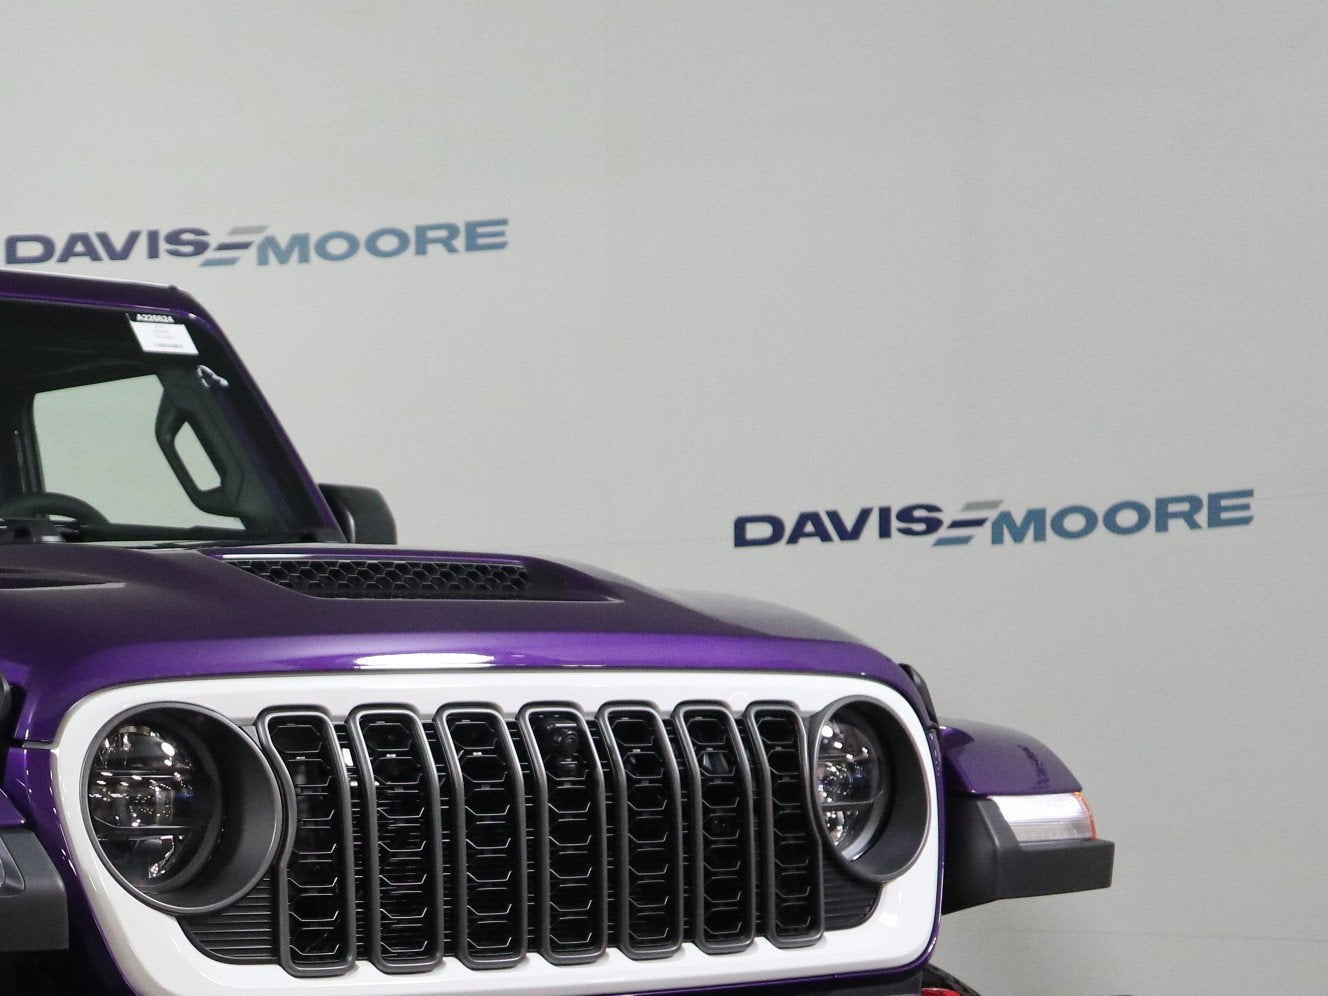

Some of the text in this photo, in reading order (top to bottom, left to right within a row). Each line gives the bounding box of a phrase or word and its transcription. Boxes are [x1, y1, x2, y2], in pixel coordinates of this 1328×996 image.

[5, 218, 510, 267] DAVIS MOORE
[733, 489, 1255, 549] DAVIS MOORE
